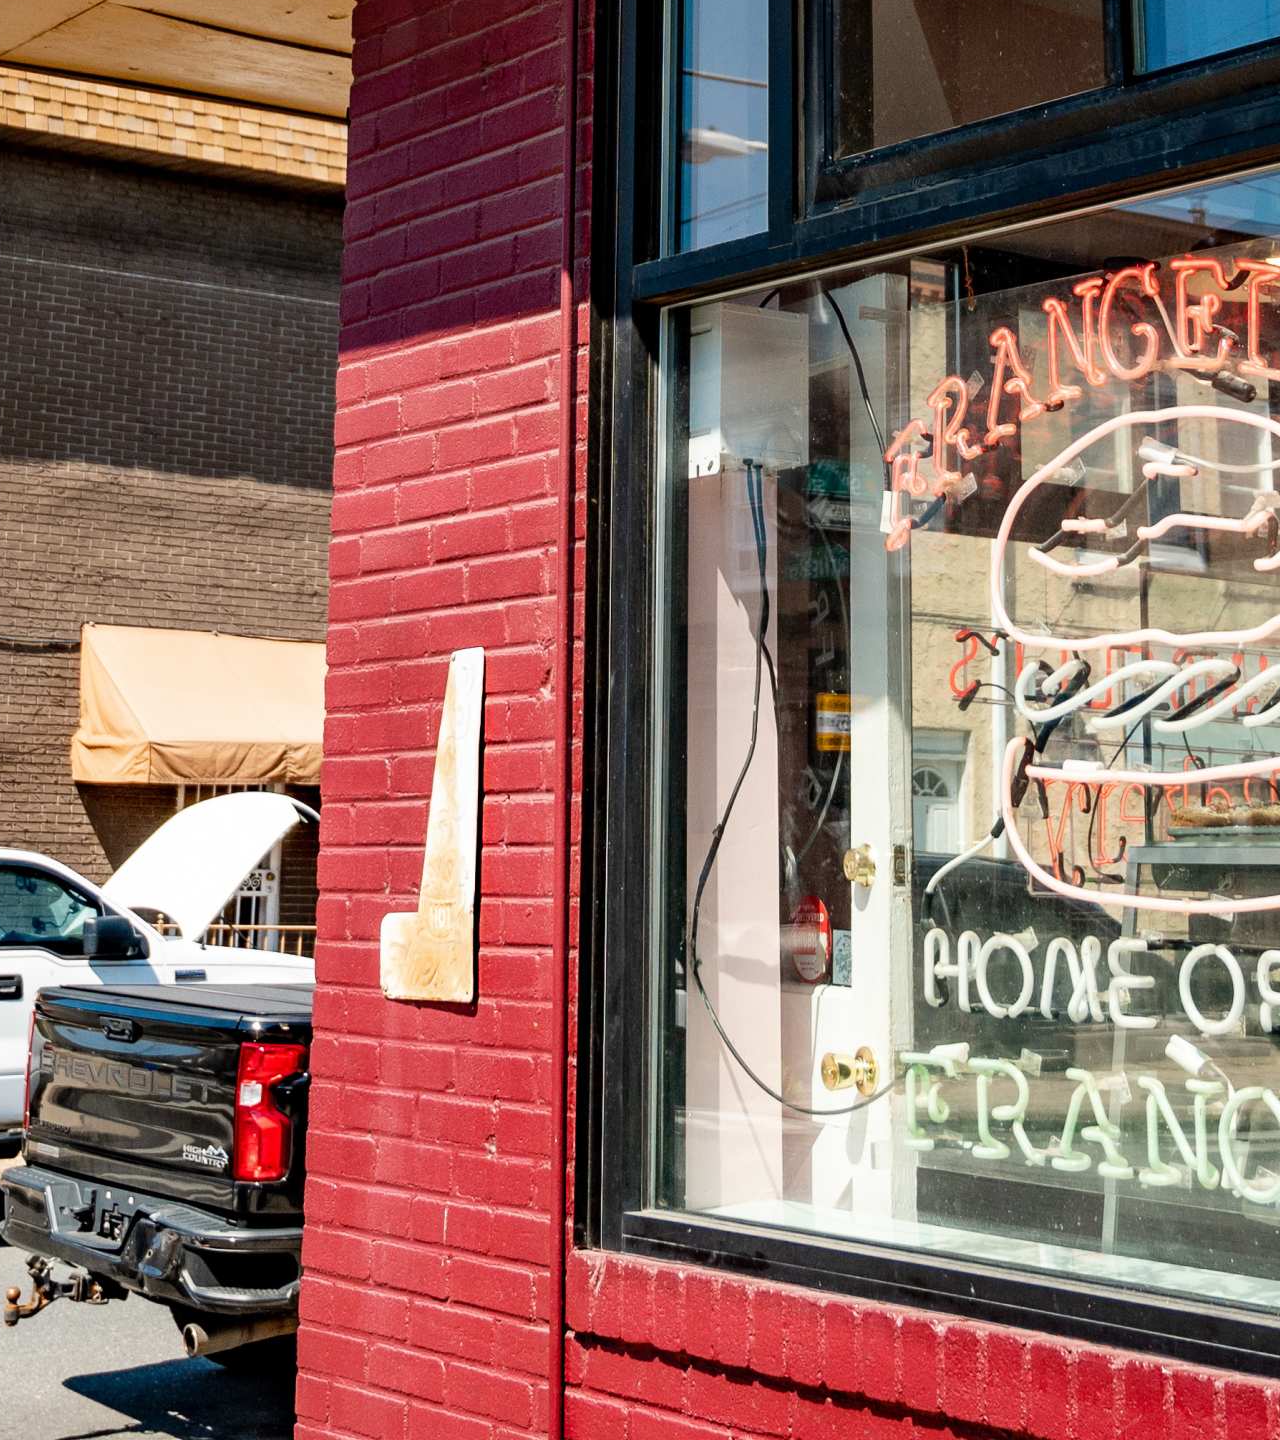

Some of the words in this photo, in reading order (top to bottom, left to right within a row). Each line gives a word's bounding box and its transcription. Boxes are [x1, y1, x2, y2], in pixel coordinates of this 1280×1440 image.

[923, 927, 1159, 1029] HOME
[40, 1048, 215, 1103] CHEVROLET
[182, 1143, 207, 1156] HIGH
[182, 1152, 227, 1168] COUNTRY
